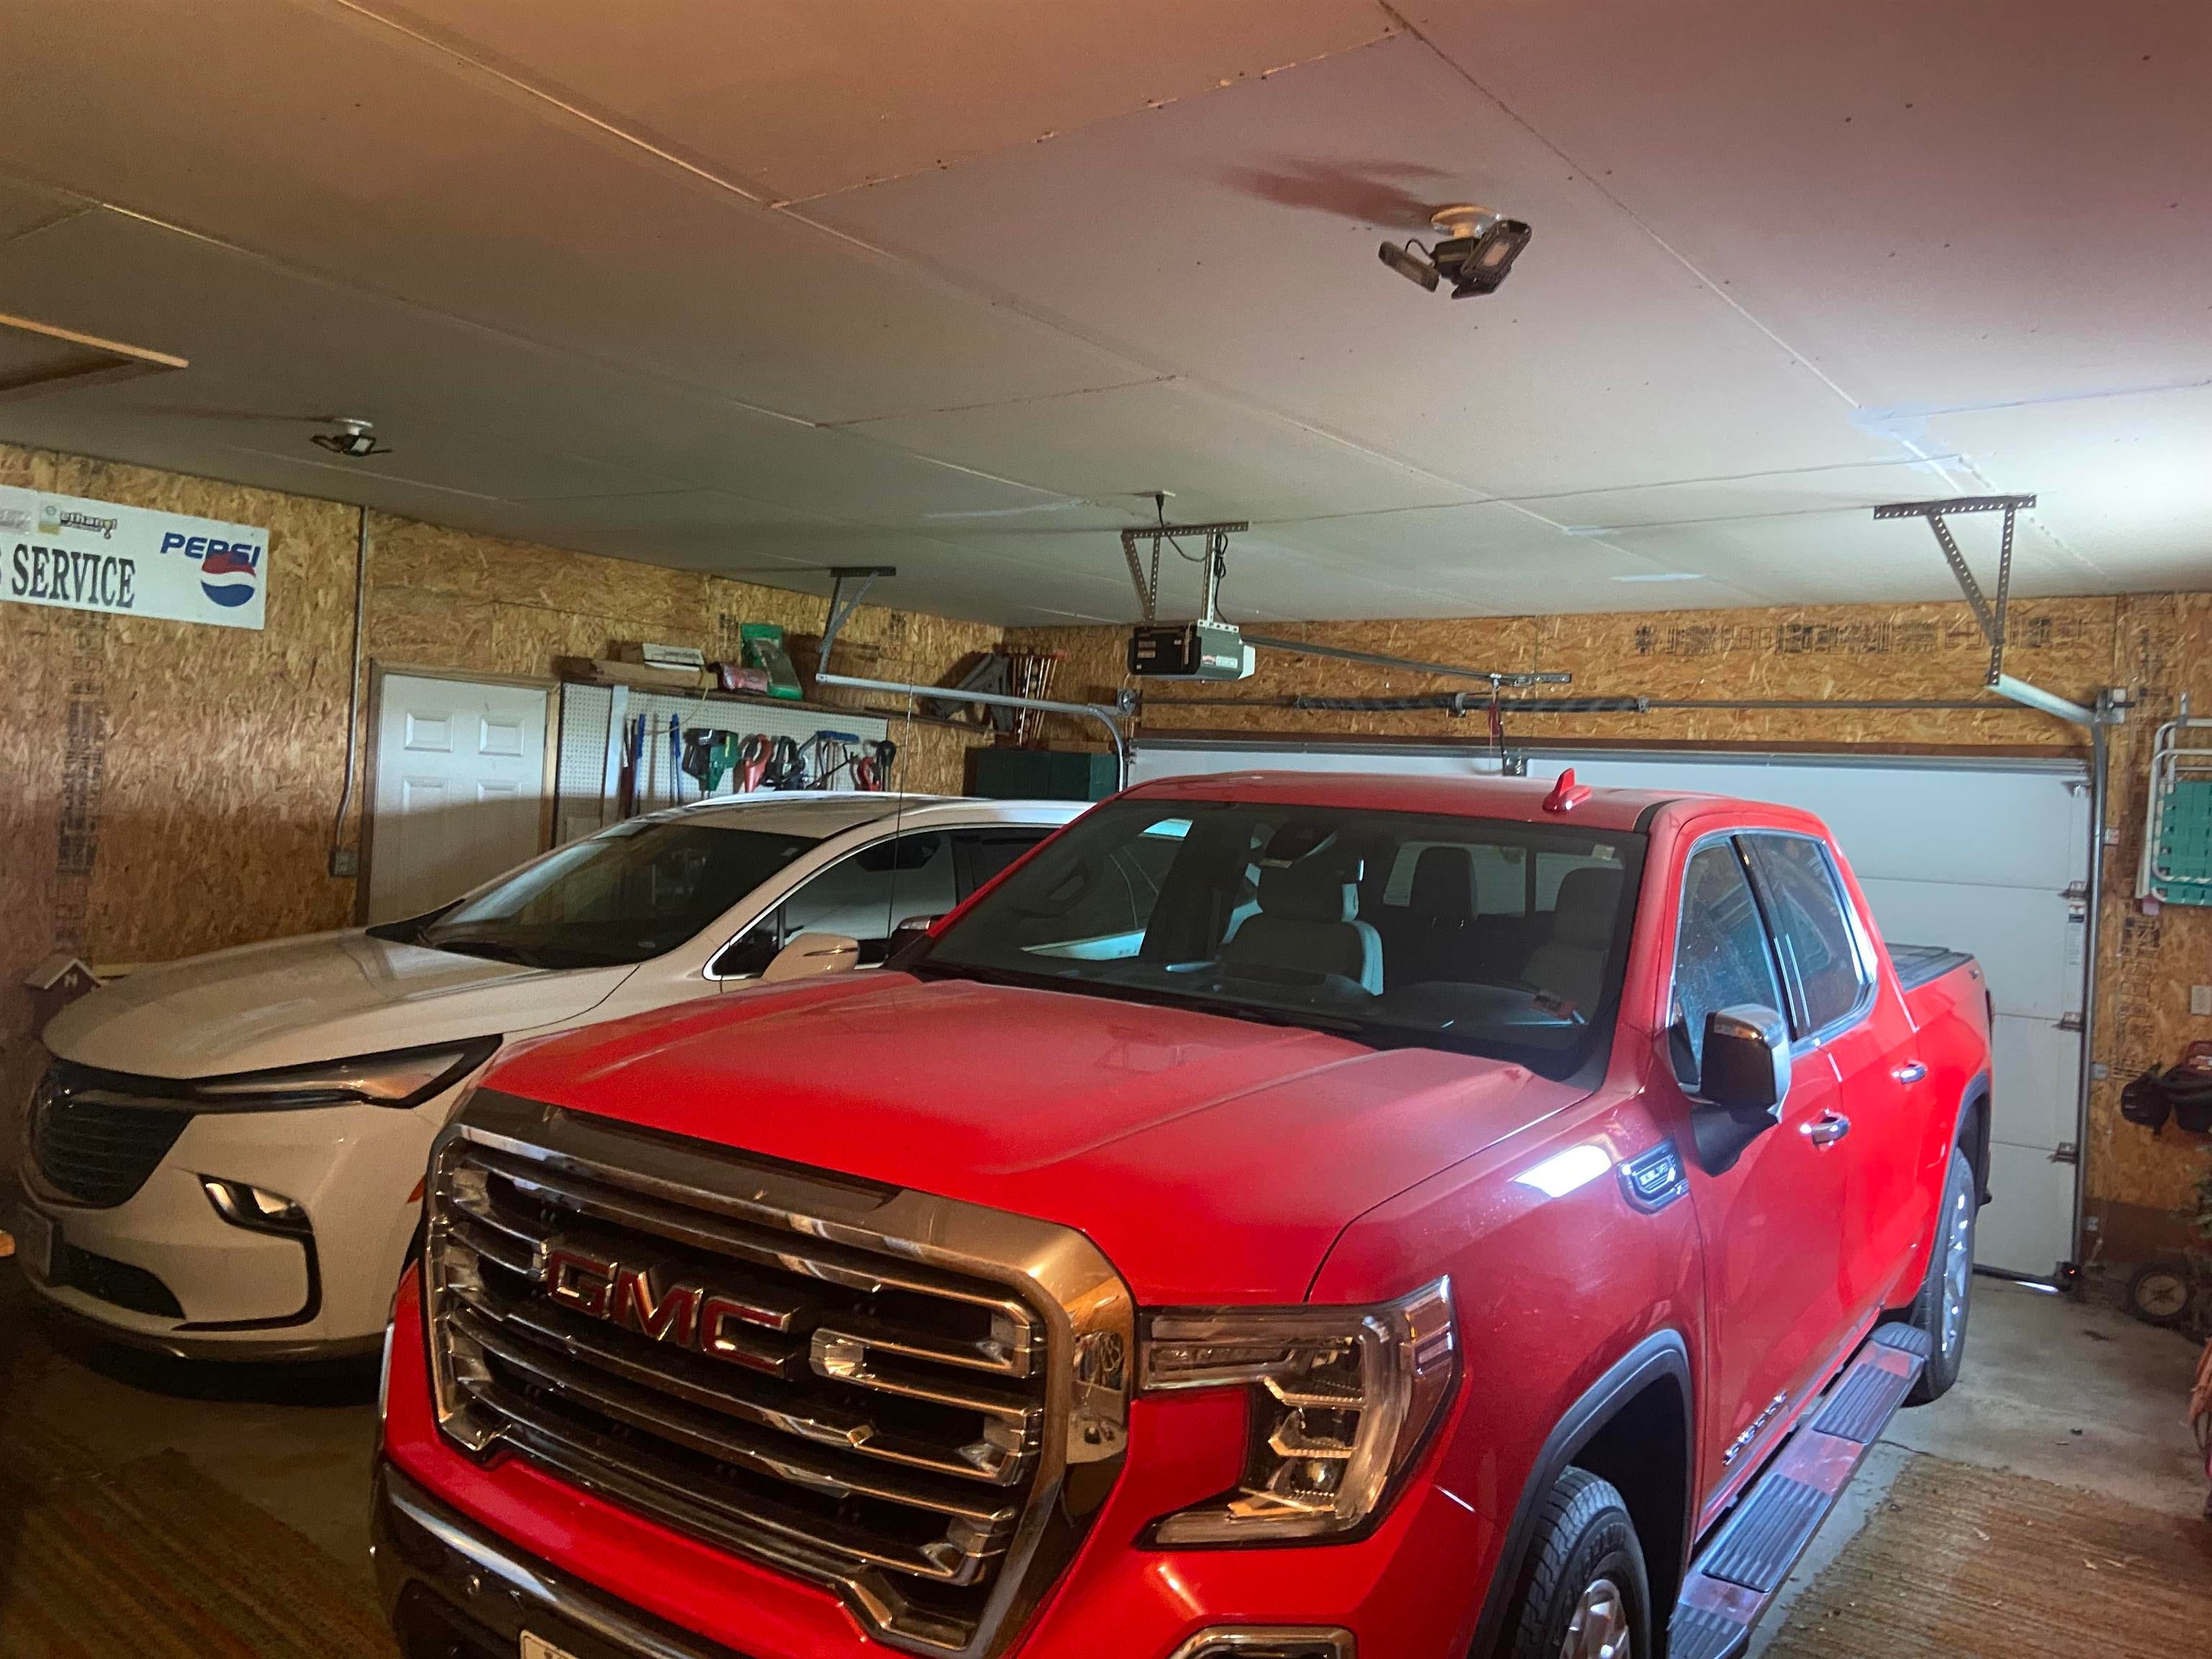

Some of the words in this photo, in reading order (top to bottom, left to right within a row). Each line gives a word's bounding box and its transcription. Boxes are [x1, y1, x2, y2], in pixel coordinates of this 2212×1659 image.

[12, 544, 135, 608] SERVICE
[160, 531, 261, 567] PEPSI
[546, 1248, 791, 1374] GMC
